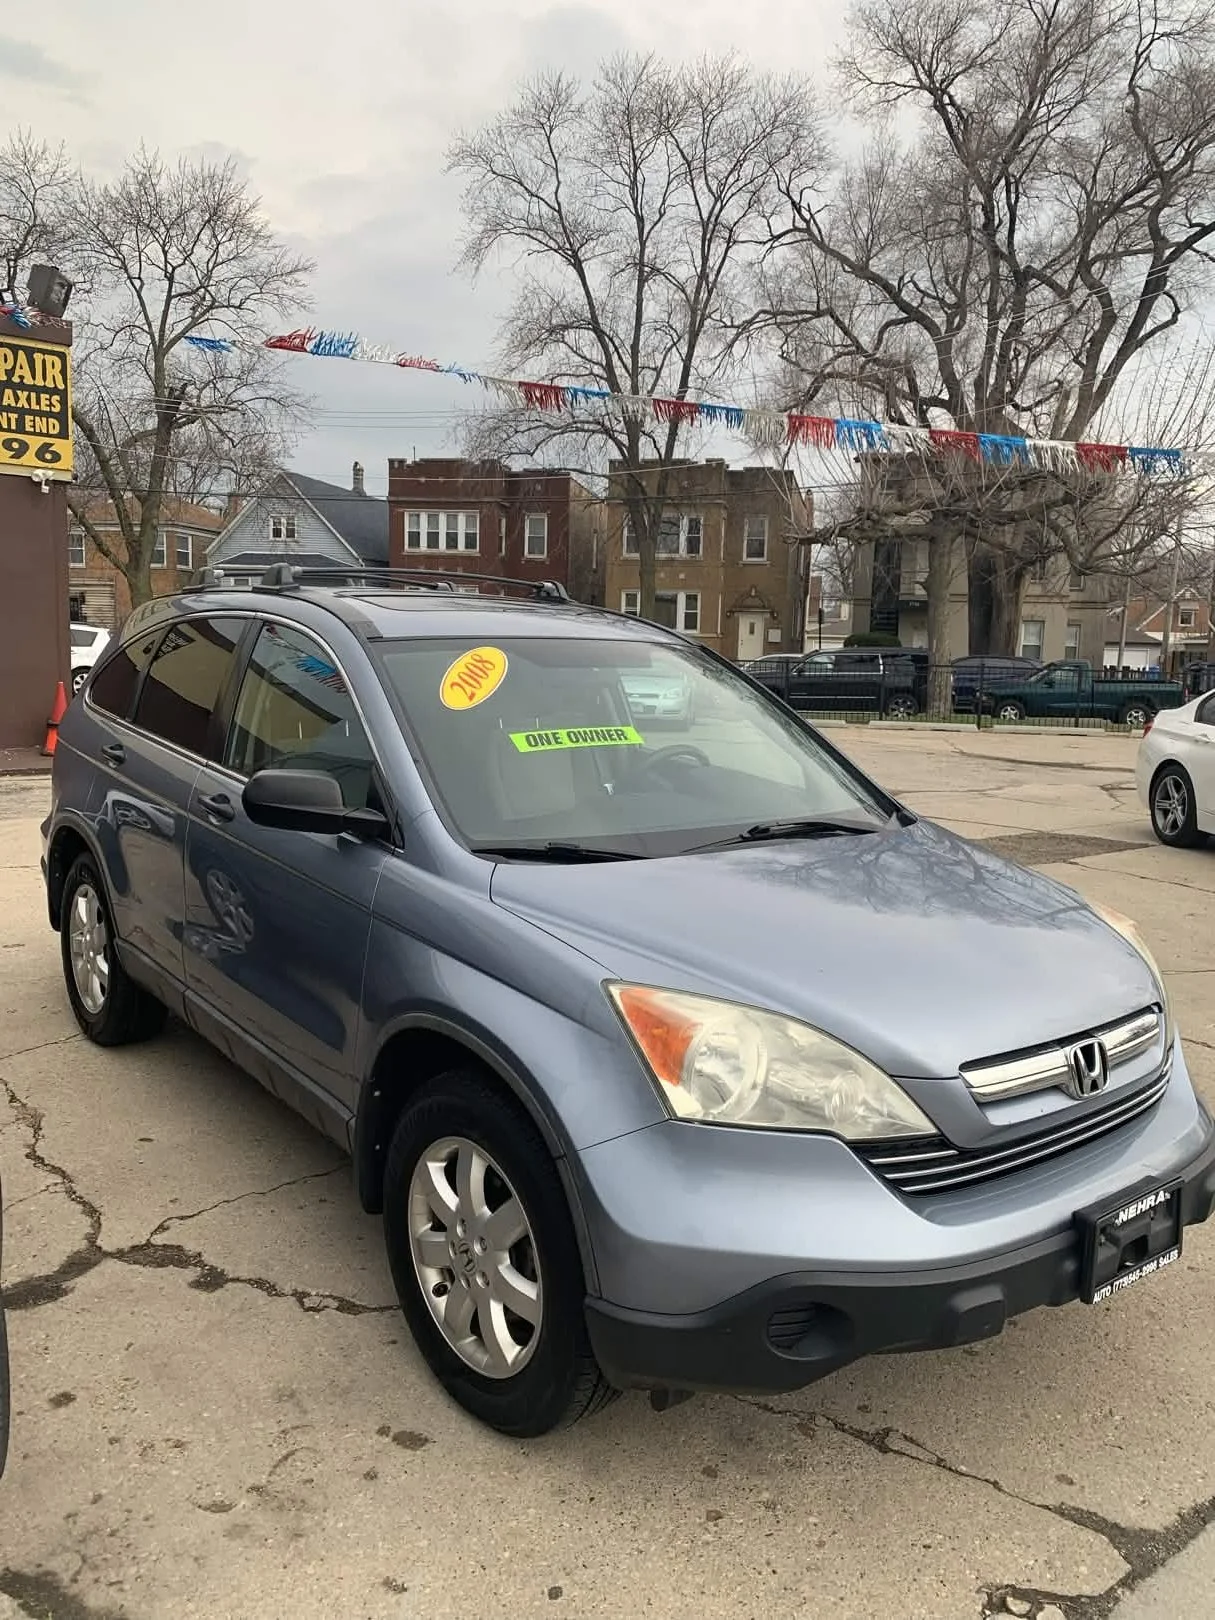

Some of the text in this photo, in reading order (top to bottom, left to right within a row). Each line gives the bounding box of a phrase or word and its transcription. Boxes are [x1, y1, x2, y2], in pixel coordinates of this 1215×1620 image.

[0, 347, 65, 390] PAIR
[2, 388, 61, 413] AXLES
[25, 415, 60, 435] END
[2, 437, 62, 464] 96
[450, 653, 496, 702] 2008
[525, 728, 628, 748] ONE OWNER
[1118, 1190, 1165, 1224] NEHRA
[1092, 1285, 1112, 1305] AUTO
[1158, 1249, 1179, 1268] SALES
